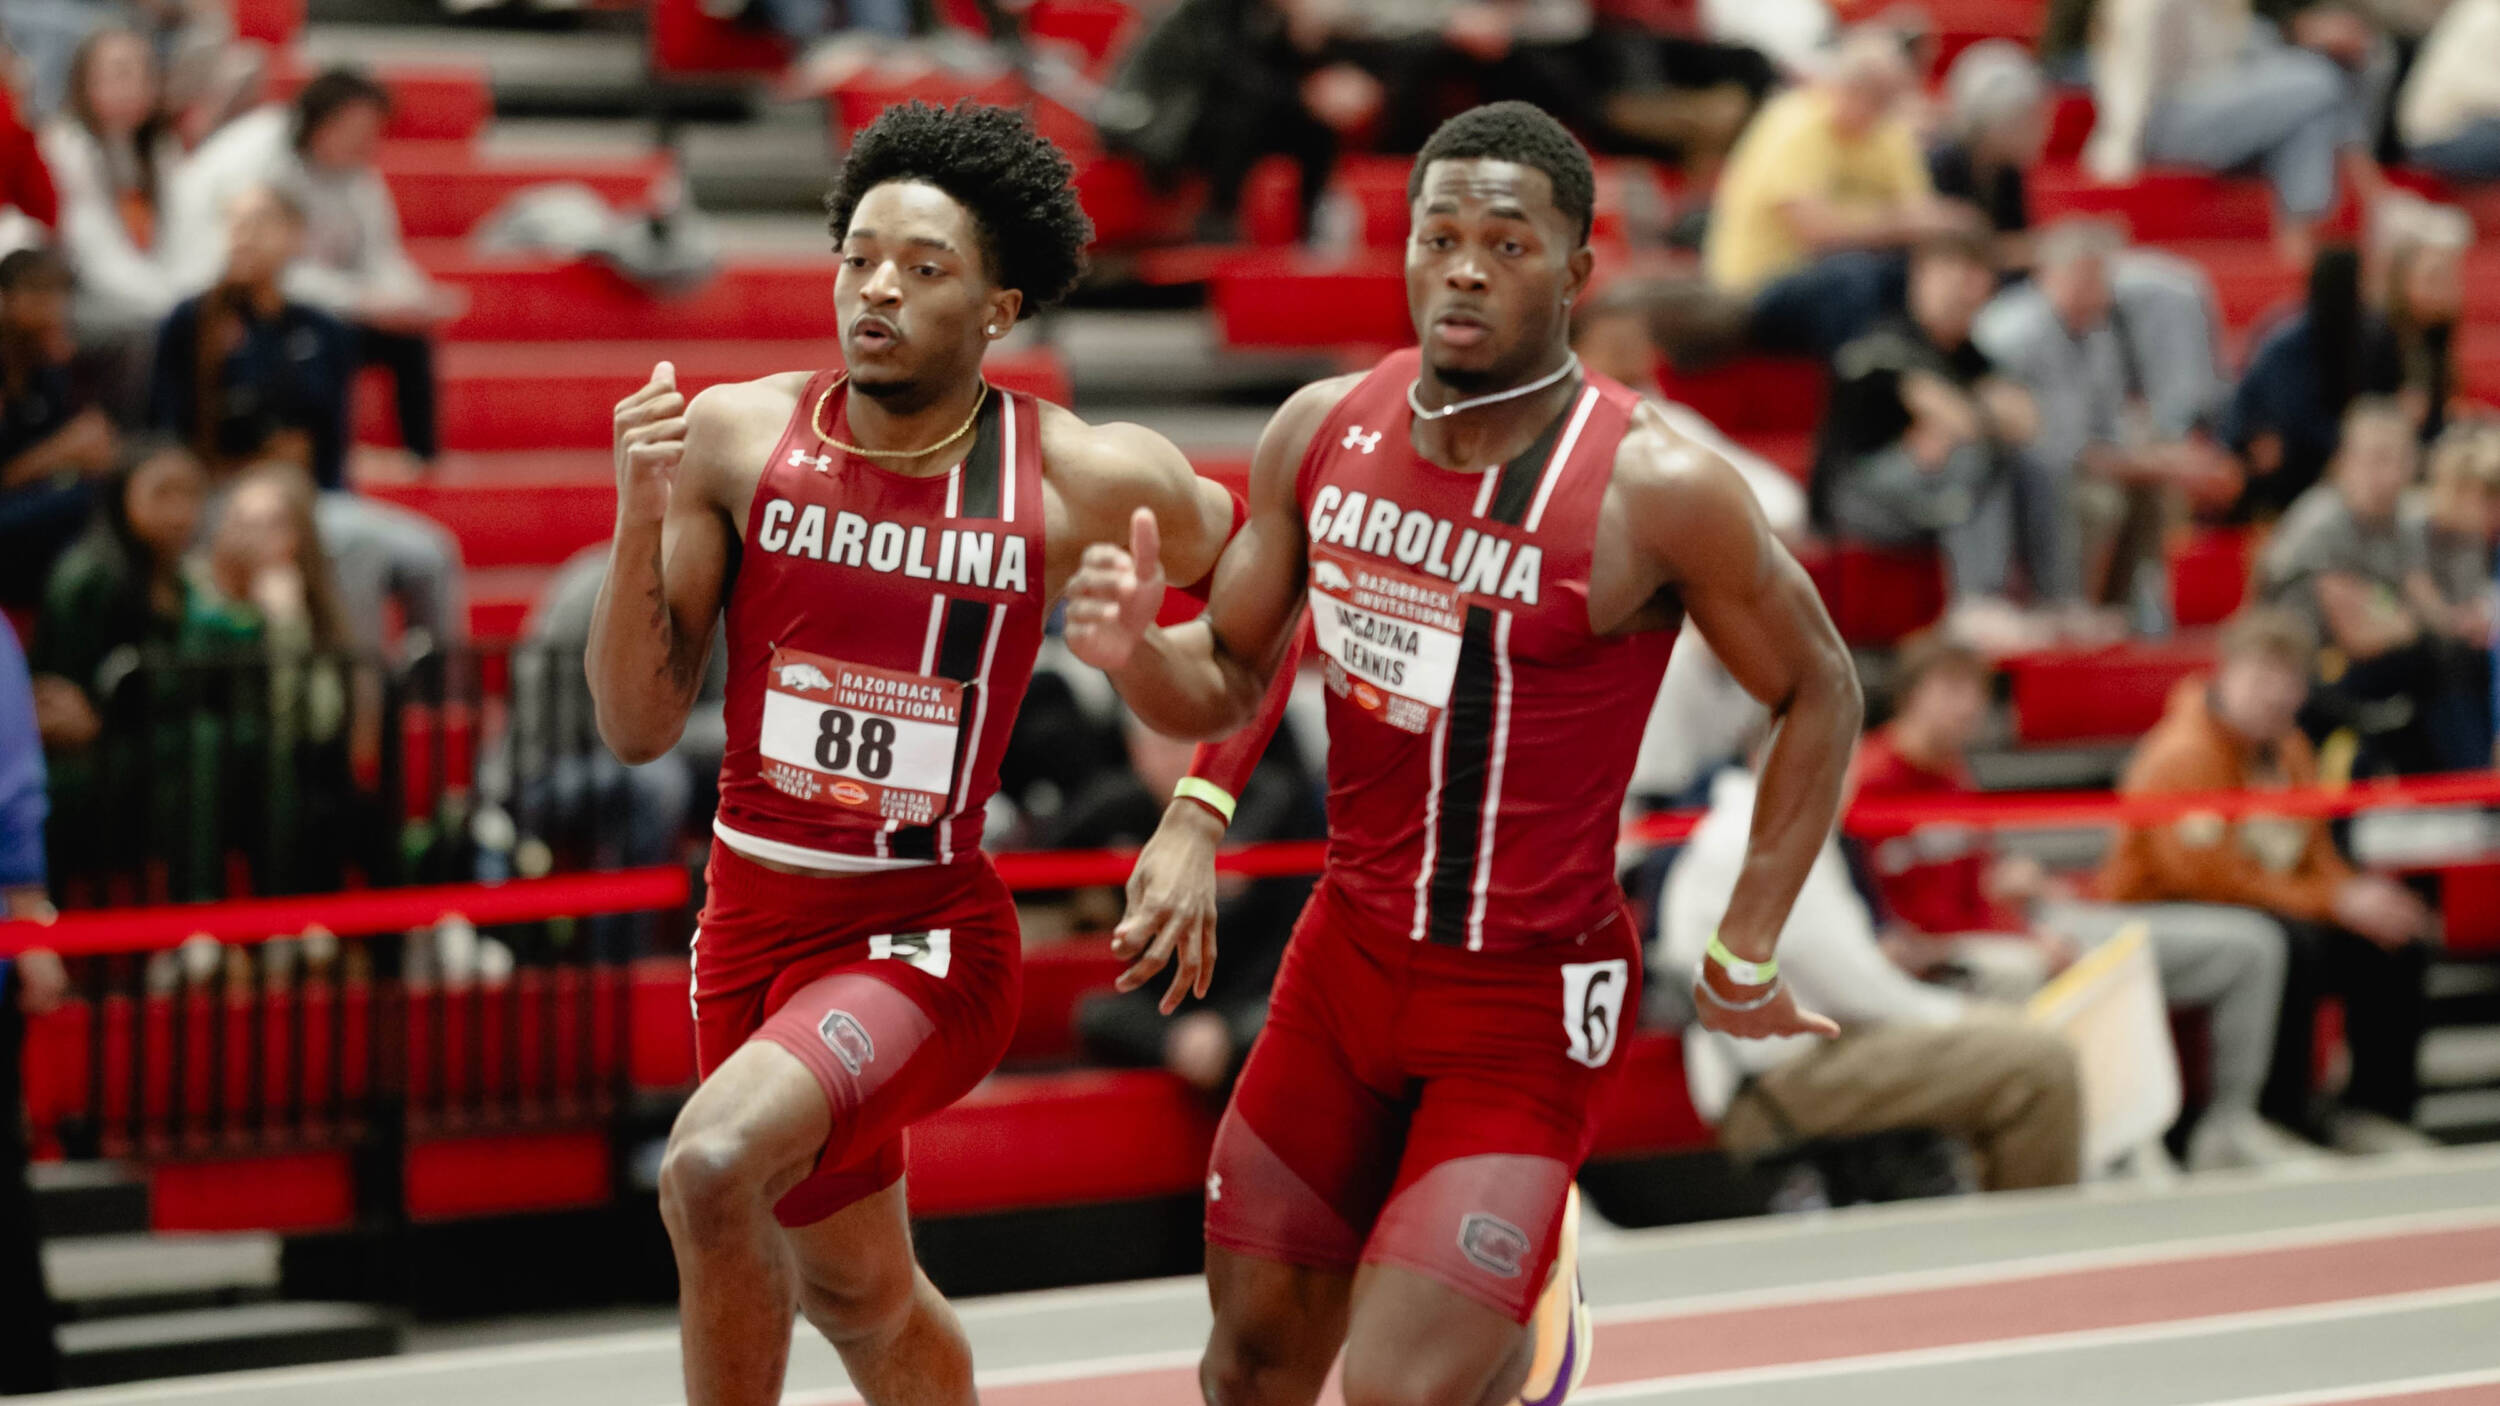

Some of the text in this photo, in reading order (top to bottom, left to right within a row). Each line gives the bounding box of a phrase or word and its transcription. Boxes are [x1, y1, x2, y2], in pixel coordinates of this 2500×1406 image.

[759, 499, 1027, 594] CAROLINA
[1309, 485, 1542, 605] CAROLINA
[1358, 571, 1450, 610] RAZORBACK
[1355, 591, 1461, 631] INVITATIONAL
[841, 672, 942, 702] RAZORBACK
[839, 692, 956, 722] INVITATIONAL
[815, 709, 896, 780] 88
[880, 806, 929, 824] CENTER
[882, 789, 932, 804] RANDAL
[1582, 970, 1610, 1060] 6
